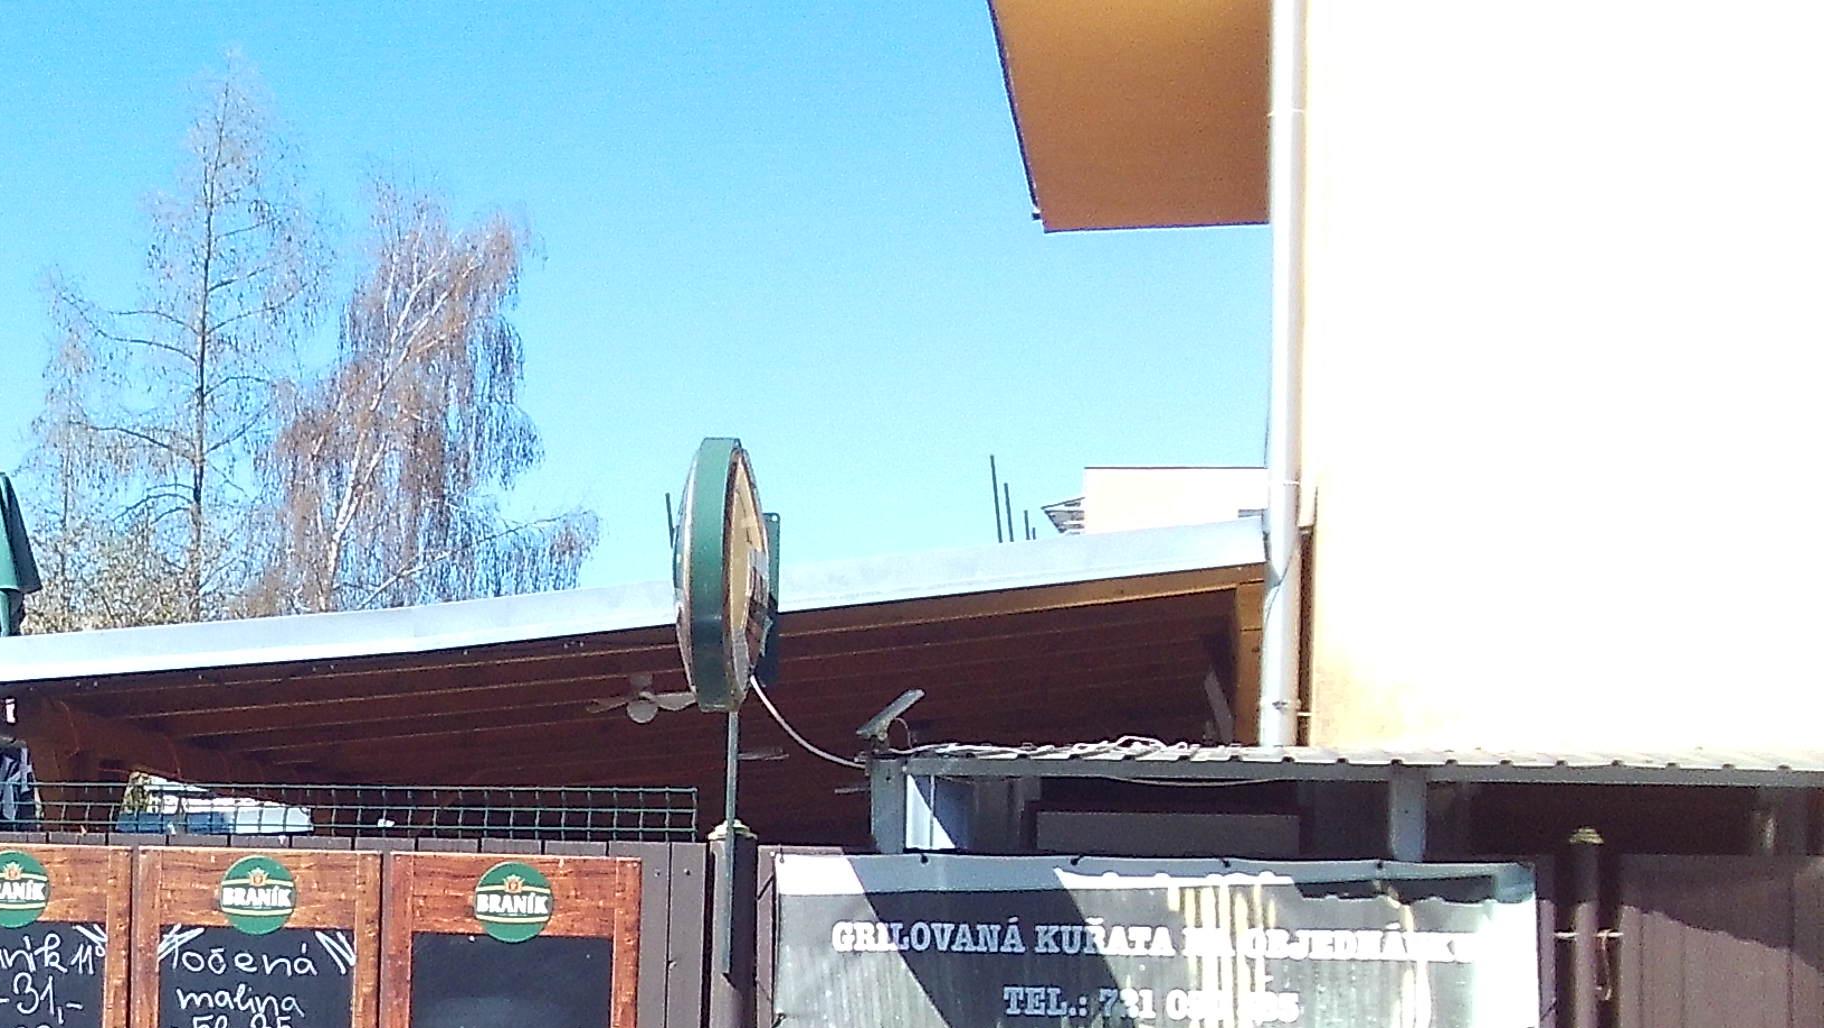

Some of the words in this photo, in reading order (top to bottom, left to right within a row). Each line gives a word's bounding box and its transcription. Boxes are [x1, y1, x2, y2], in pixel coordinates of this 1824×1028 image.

[222, 885, 292, 908] BRANÍK
[477, 892, 550, 915] BRANÍK
[831, 917, 1026, 954] GRILOVANÁ
[1034, 917, 1175, 957] KUŘATA
[176, 983, 305, 1019] malina
[1004, 985, 1088, 1017] TEL.:
